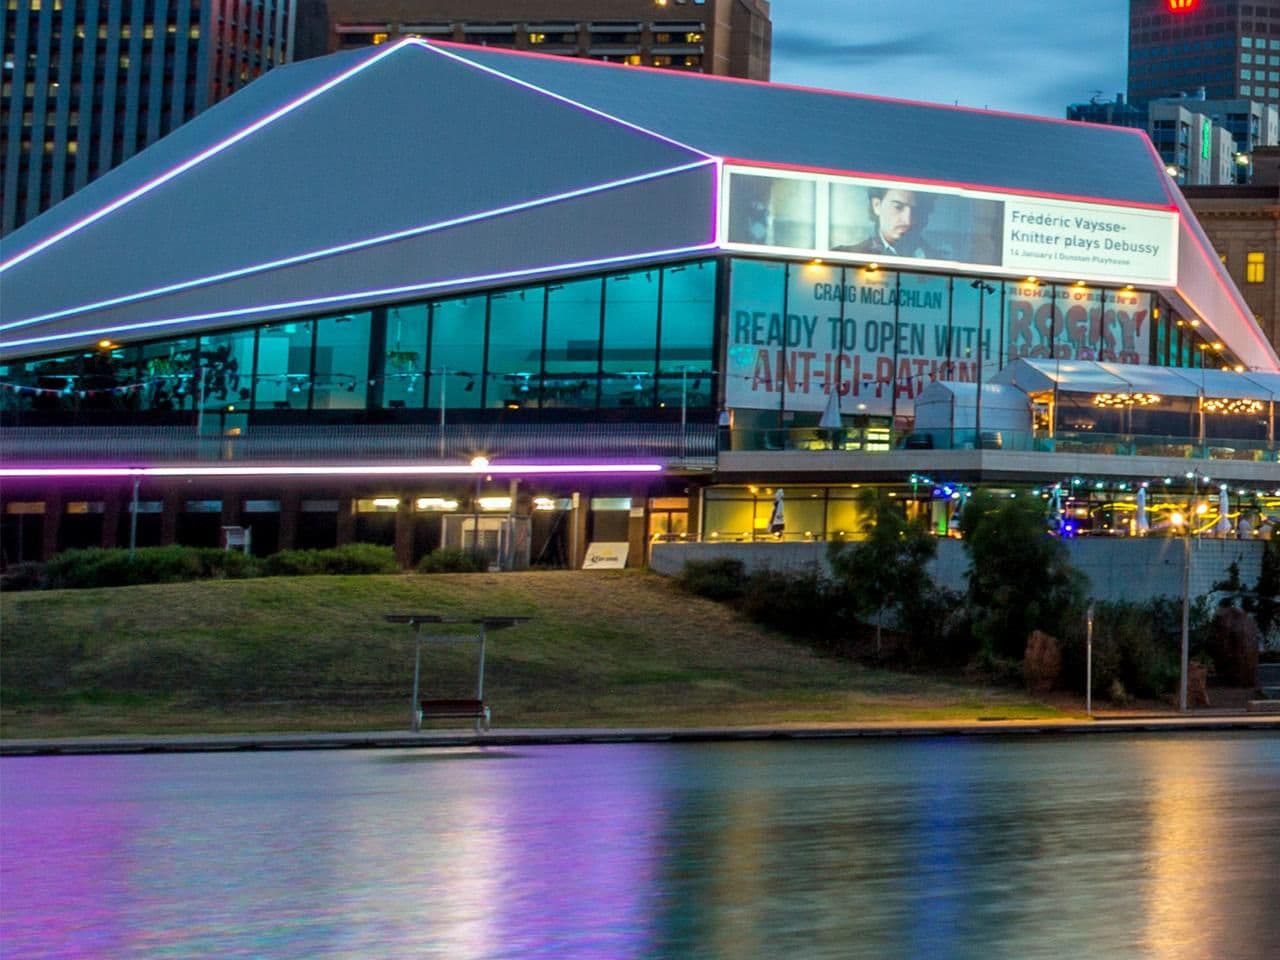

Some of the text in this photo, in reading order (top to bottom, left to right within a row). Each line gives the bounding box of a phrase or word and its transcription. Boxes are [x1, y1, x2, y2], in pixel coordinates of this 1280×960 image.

[1011, 210, 1127, 233] Frédéric Vaysse-
[1011, 229, 1160, 257] Knitter plays Debussy
[1021, 248, 1053, 260] January
[814, 282, 857, 304] CRAIG
[735, 310, 992, 360] READY TO OPEN WITH
